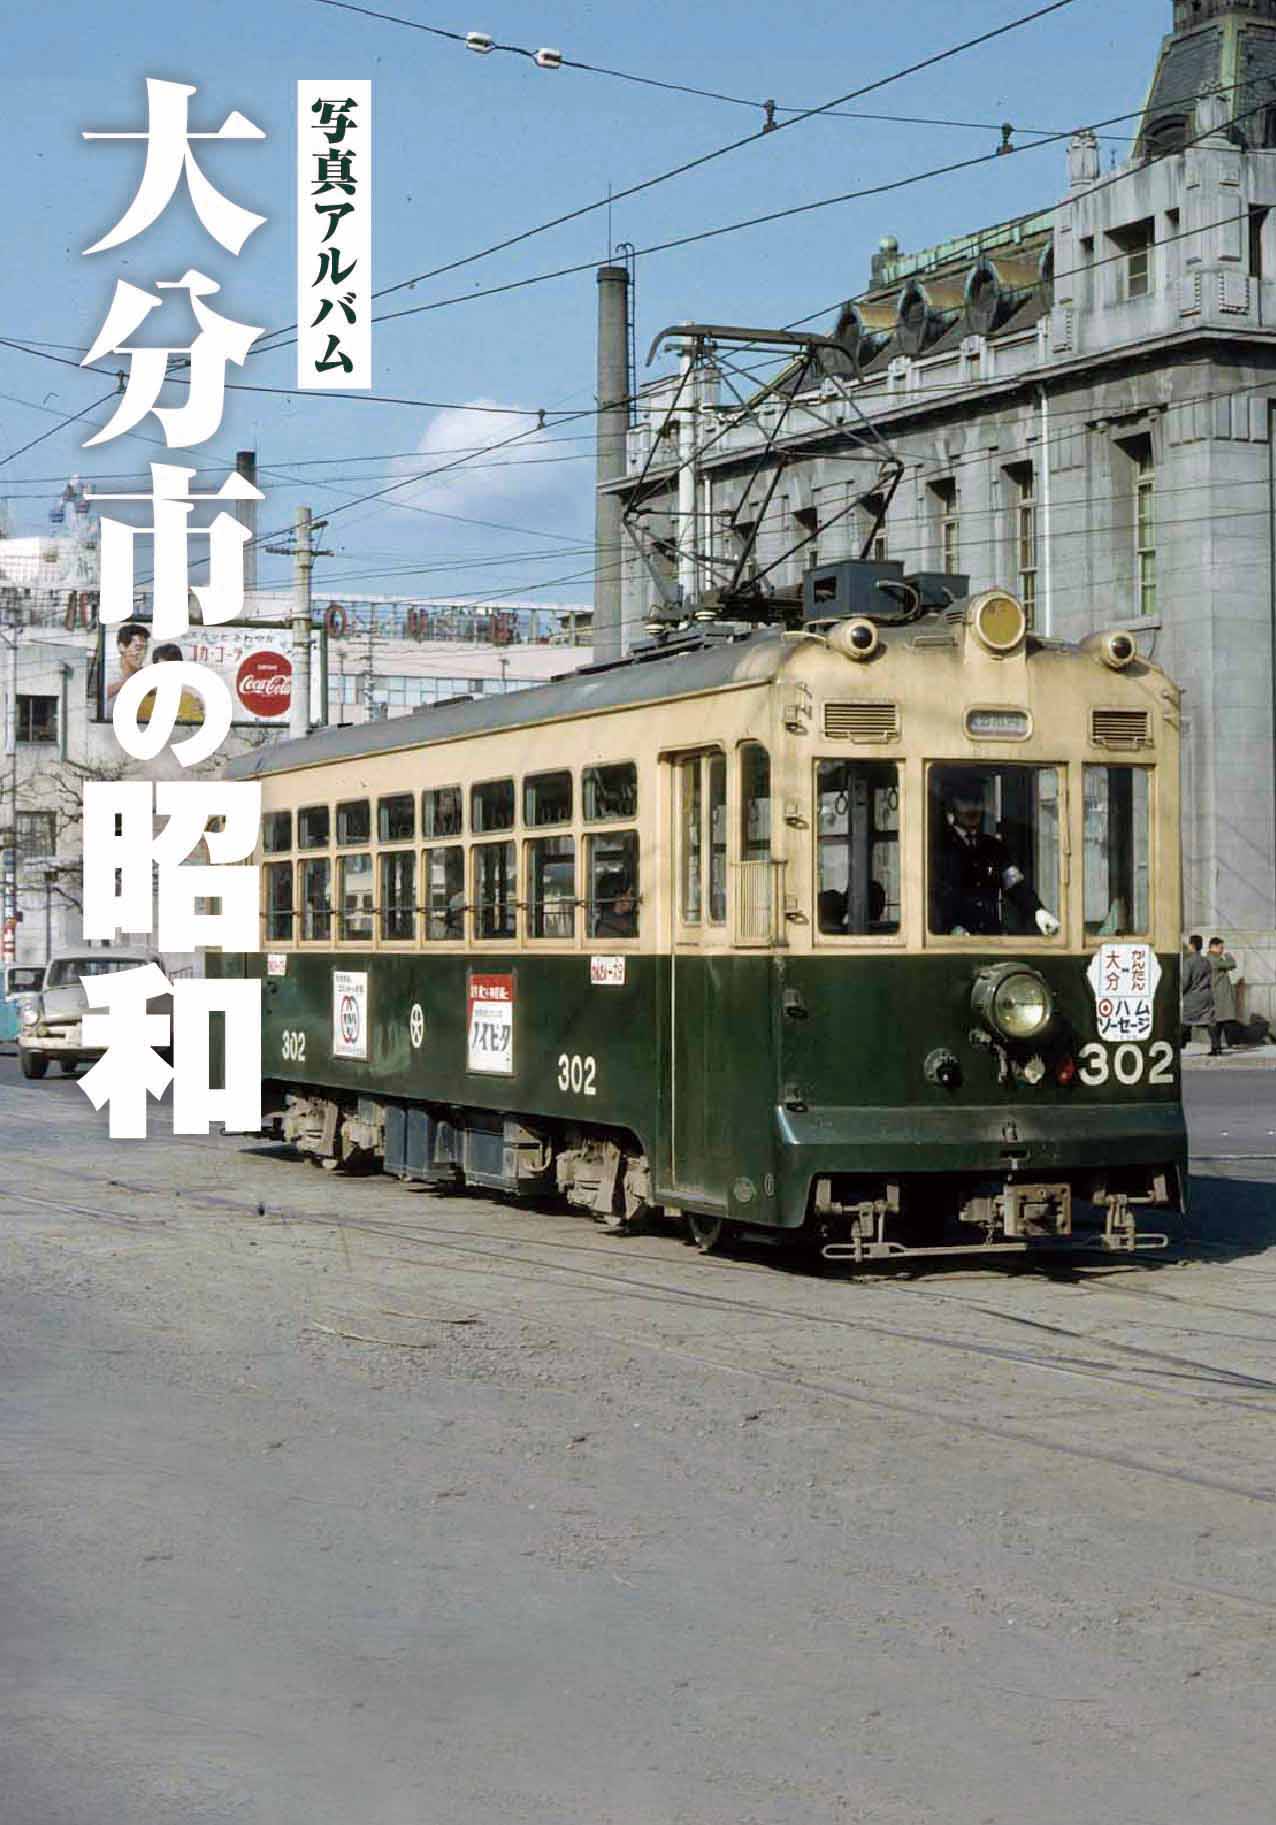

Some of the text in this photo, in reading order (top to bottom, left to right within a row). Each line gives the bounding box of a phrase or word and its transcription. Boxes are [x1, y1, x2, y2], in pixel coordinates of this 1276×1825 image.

[1105, 950, 1120, 991] 大分
[1131, 949, 1146, 991] かんたん
[282, 1029, 306, 1062] 302
[1098, 1017, 1150, 1034] ソーセージ
[557, 1053, 597, 1096] 302
[1079, 1041, 1174, 1086] 302
